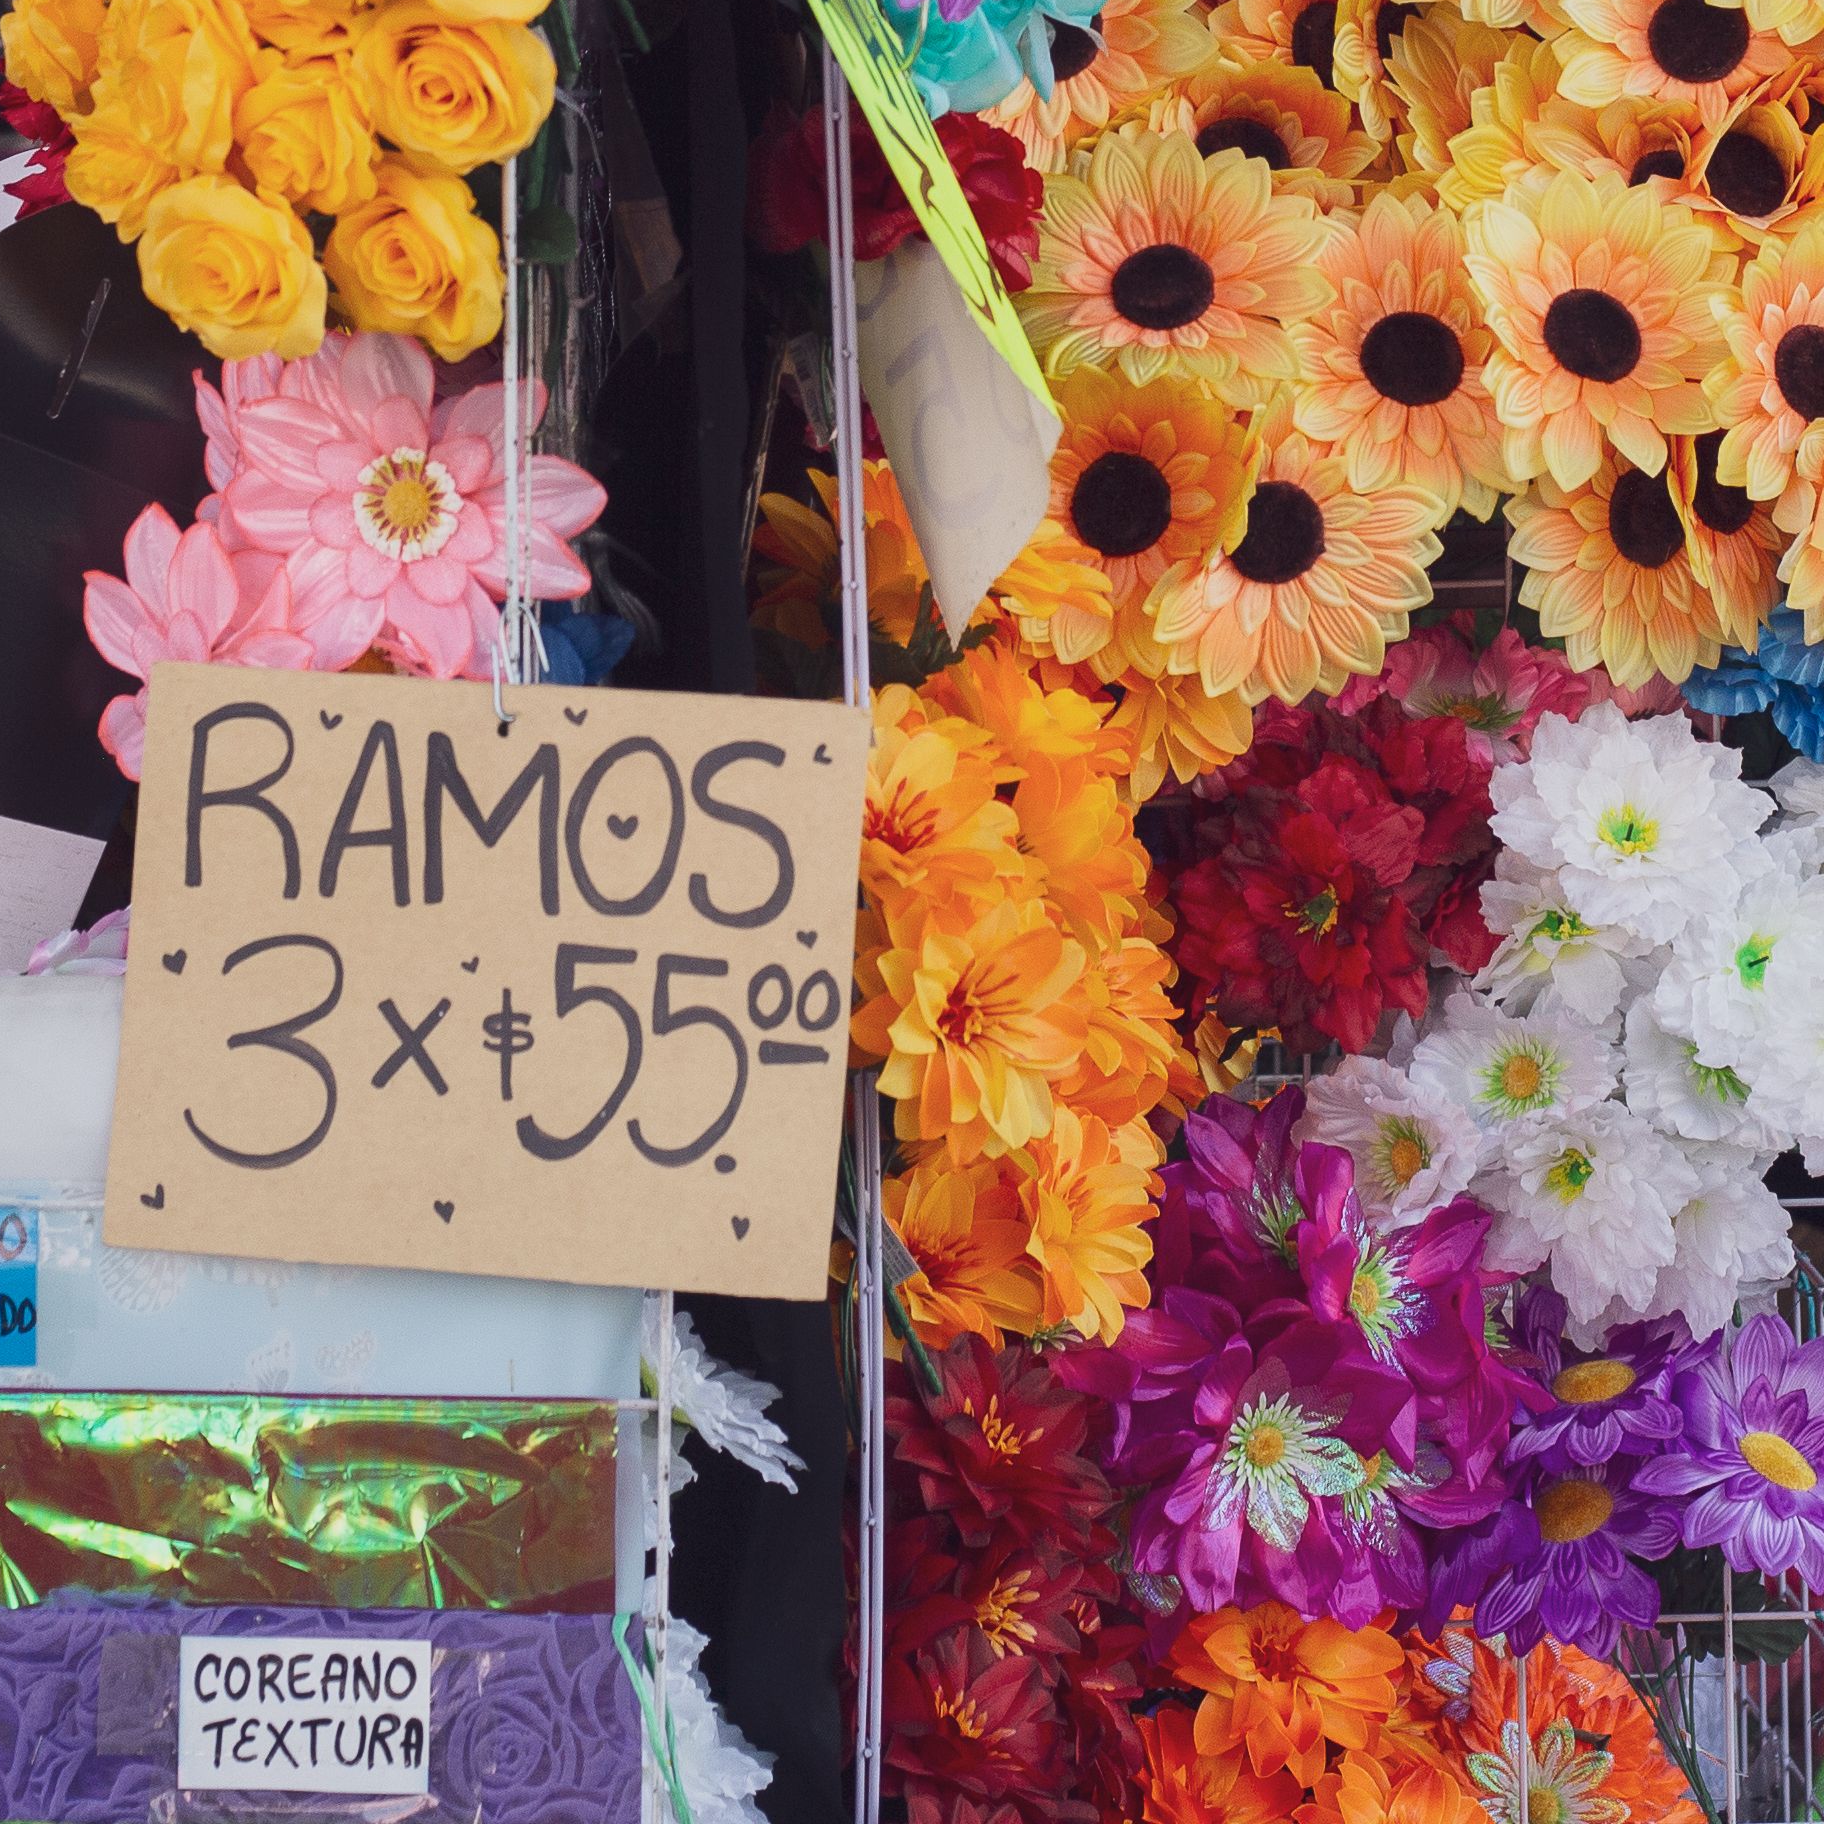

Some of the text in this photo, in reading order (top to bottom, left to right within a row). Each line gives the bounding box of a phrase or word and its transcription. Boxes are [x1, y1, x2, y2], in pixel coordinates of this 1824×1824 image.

[184, 701, 795, 929] RAMOS
[182, 933, 344, 1170] 3
[193, 1651, 418, 1704] COREANO
[201, 1712, 425, 1771] TEXTURA
